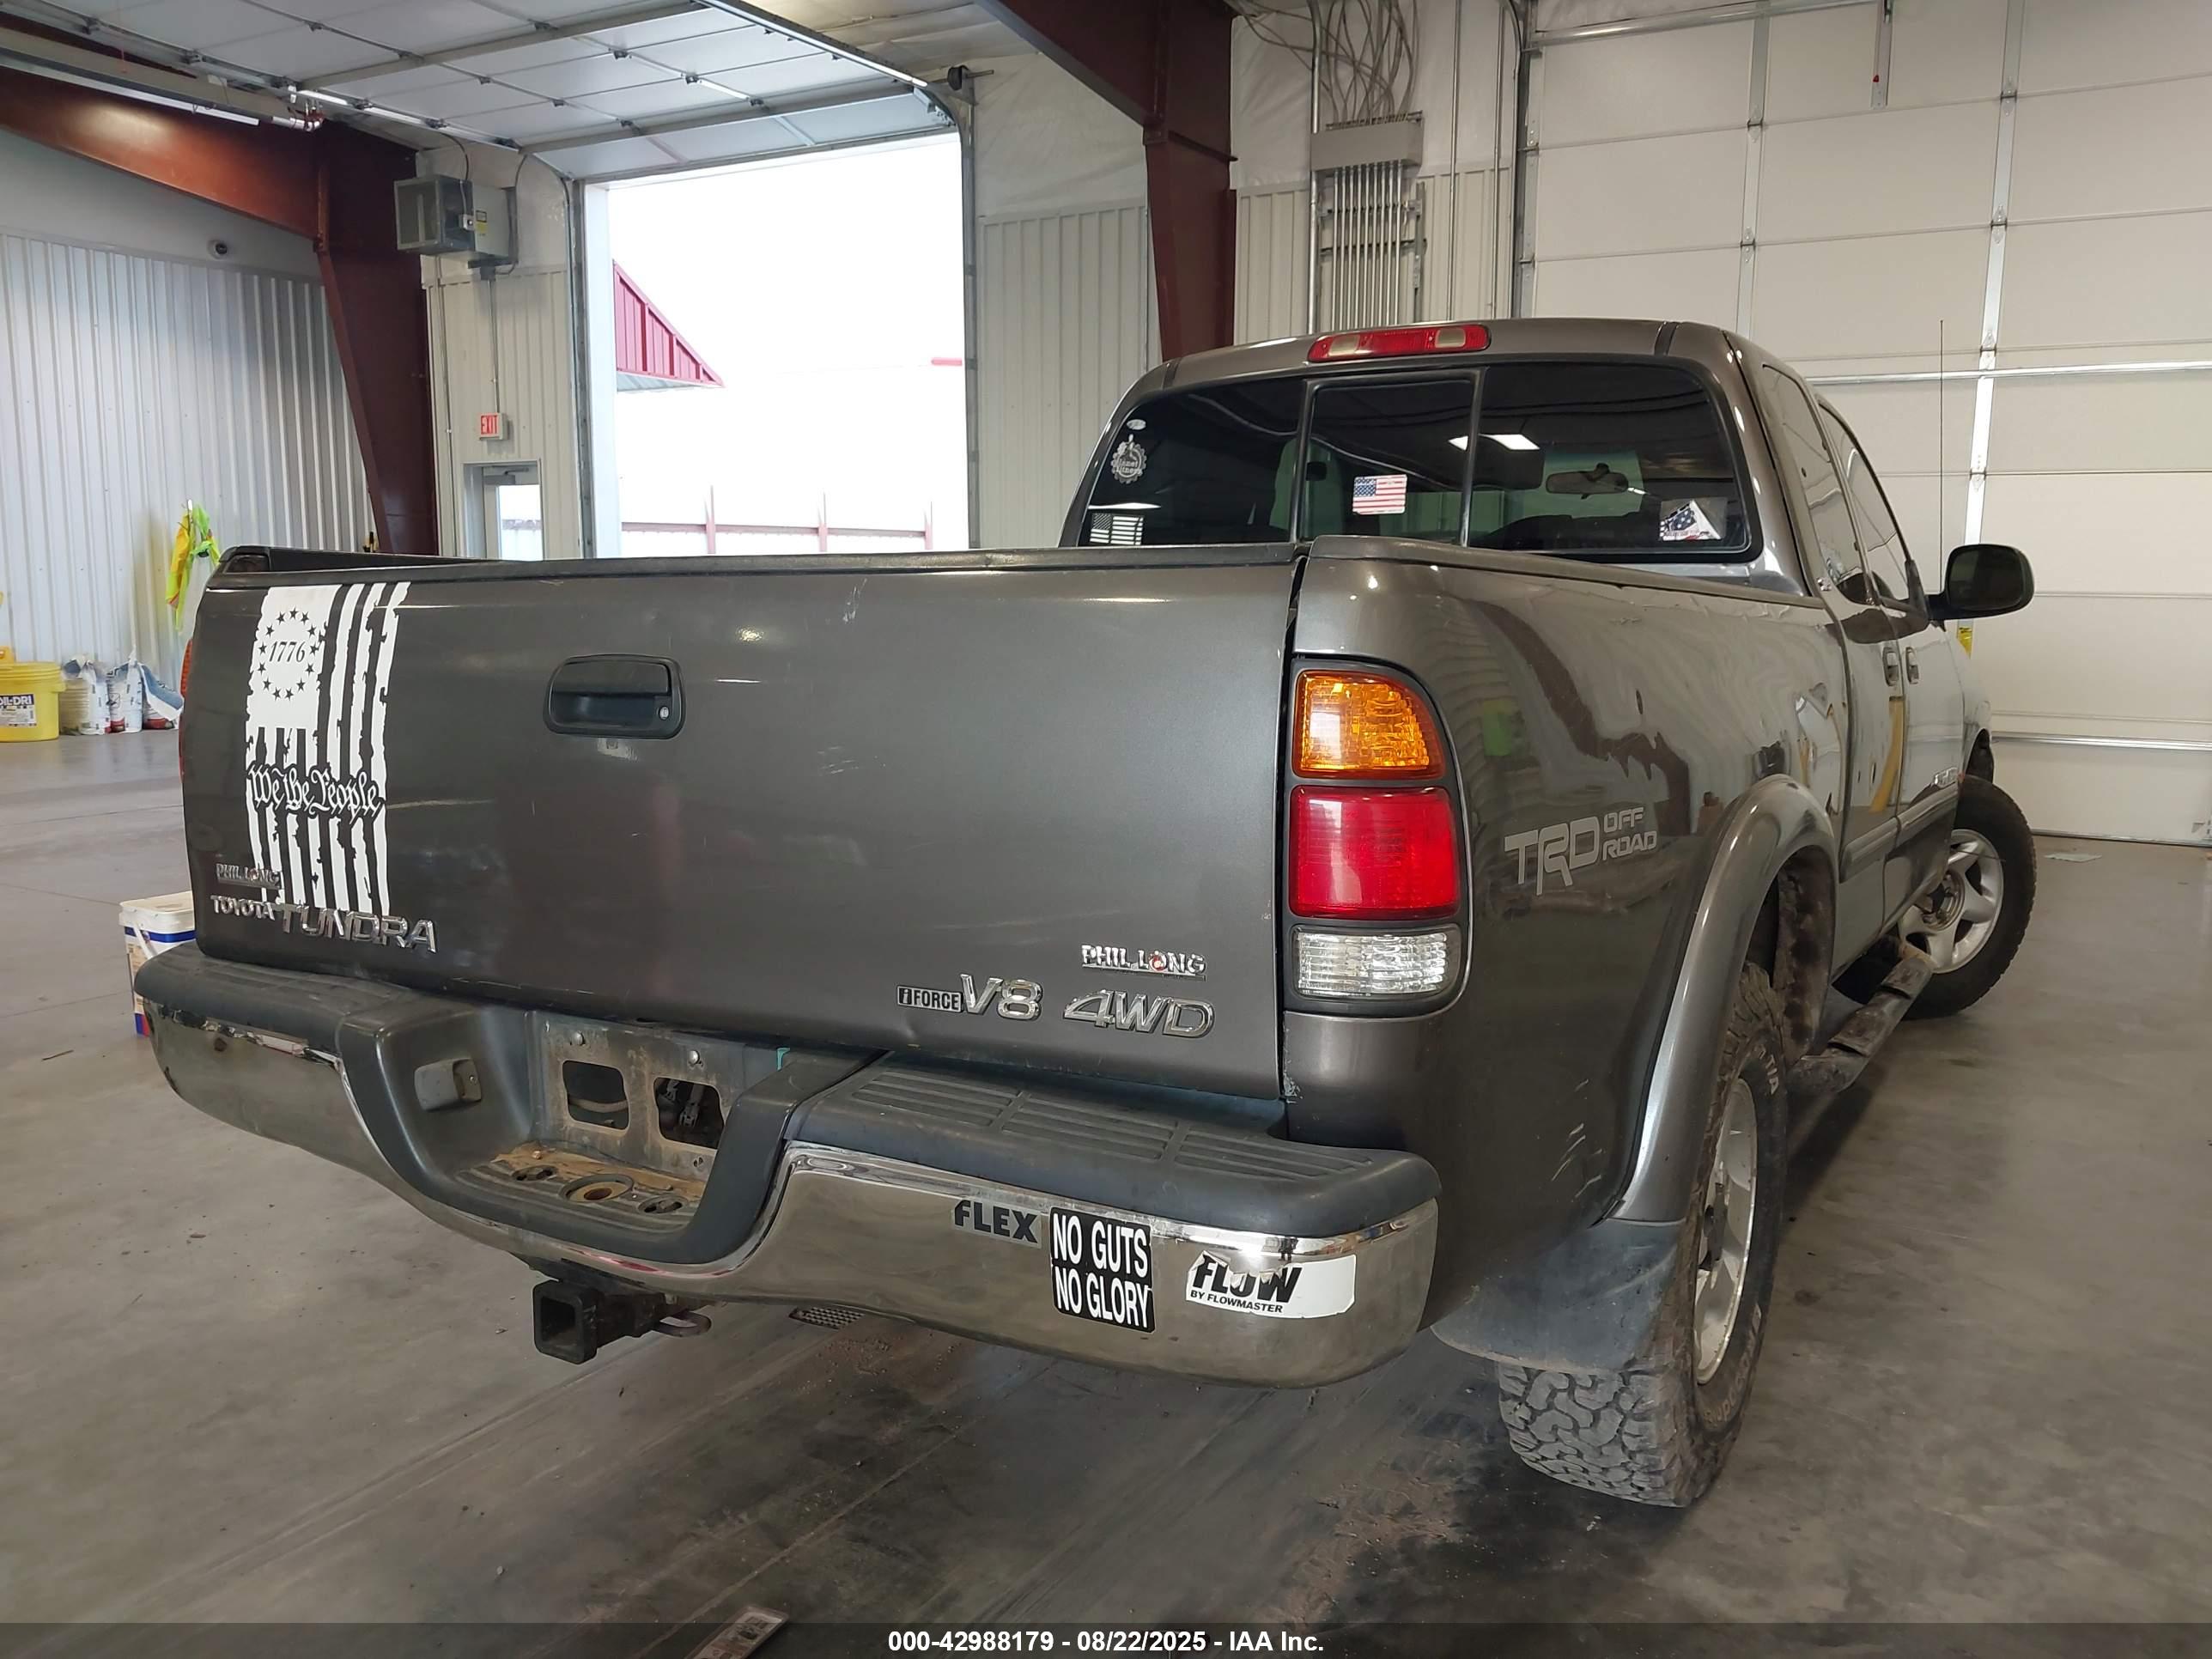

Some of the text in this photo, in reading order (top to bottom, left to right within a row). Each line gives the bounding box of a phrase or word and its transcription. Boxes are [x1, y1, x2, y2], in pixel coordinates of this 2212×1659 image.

[481, 415, 498, 434] EXIT
[269, 641, 306, 662] 1776
[248, 764, 284, 810] We
[309, 769, 380, 824] People
[1603, 807, 1644, 833] OFF
[1504, 816, 1601, 896] TRD
[1602, 830, 1657, 861] ROAD
[216, 863, 280, 884] PHIL LONG
[210, 895, 436, 953] TOYOTA TUNDRA
[1082, 945, 1206, 974] PHIL LONG
[960, 974, 1043, 1021] V8
[1064, 989, 1215, 1039] 4WD
[955, 1200, 1038, 1243] FLEX
[1053, 1212, 1148, 1278] NO GUTS
[1054, 1266, 1149, 1328] NO GLORY
[1190, 1290, 1283, 1313] BY FLOWMASTER
